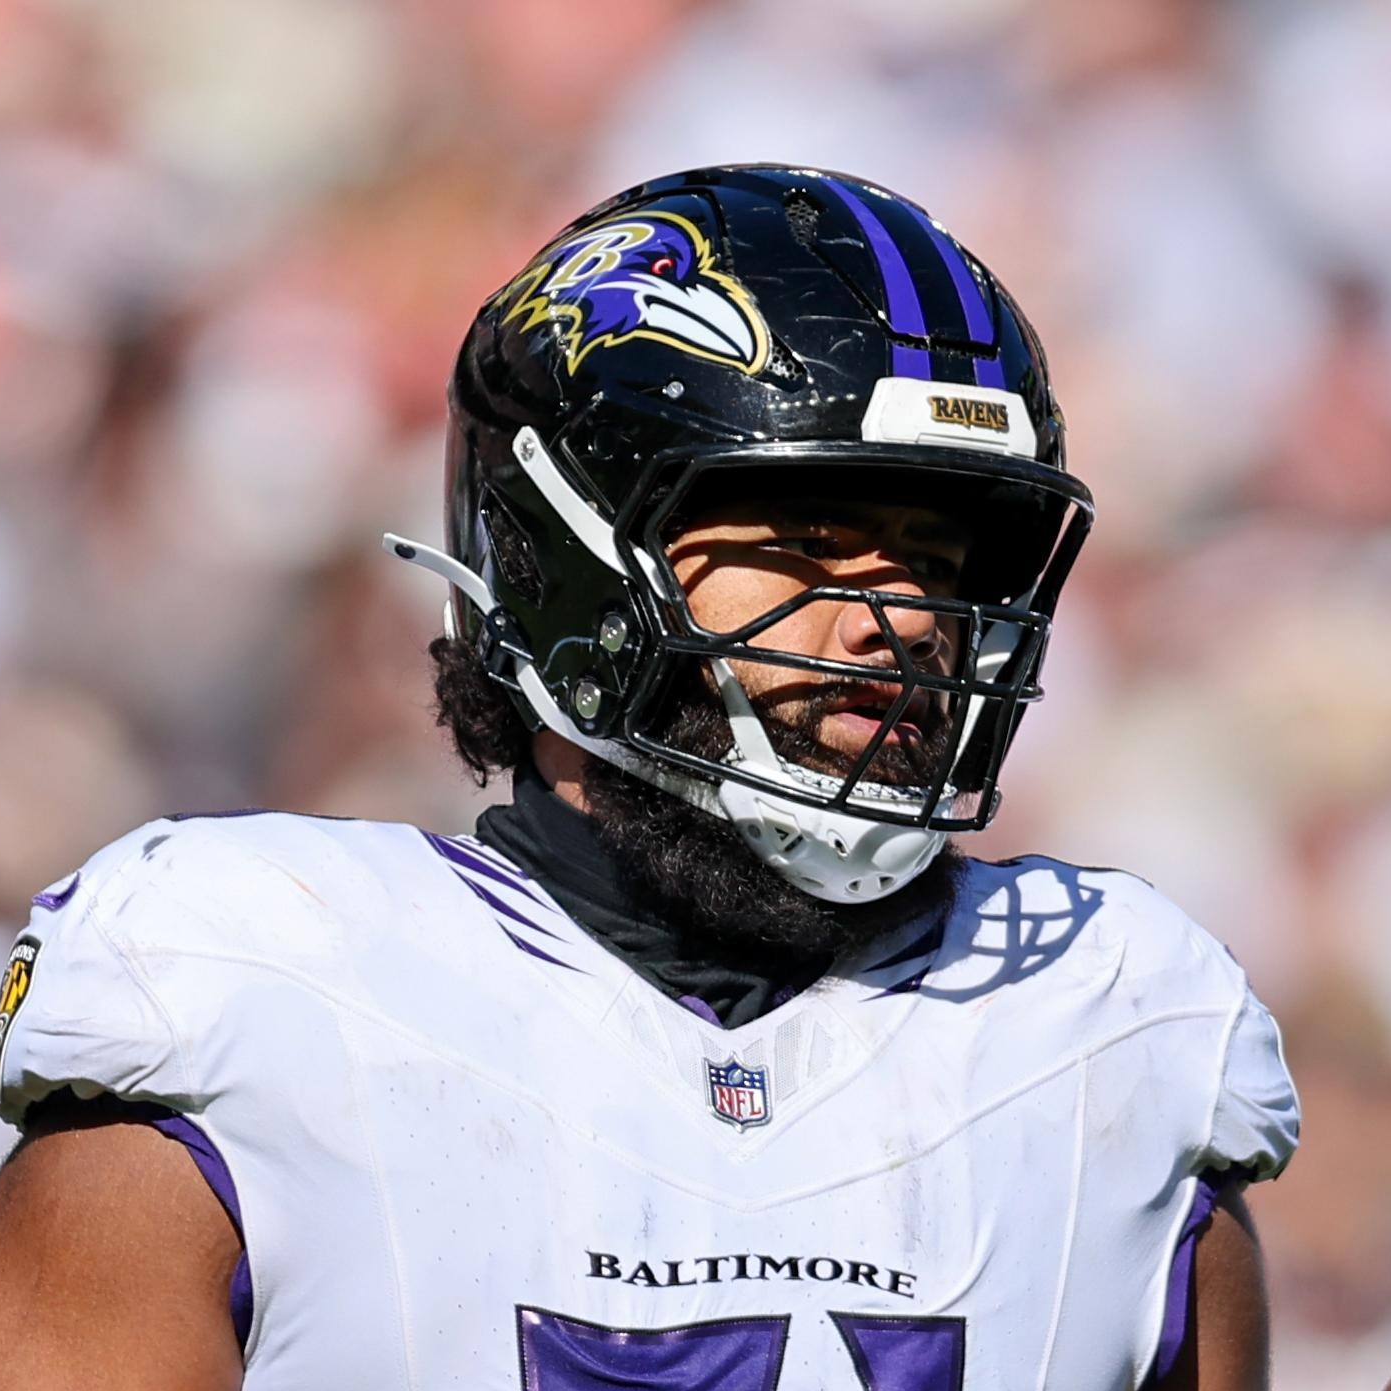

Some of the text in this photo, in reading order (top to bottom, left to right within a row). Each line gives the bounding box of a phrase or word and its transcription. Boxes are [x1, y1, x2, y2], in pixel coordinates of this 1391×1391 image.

[927, 396, 1009, 433] RAVENS
[715, 1085, 762, 1119] NFL
[585, 1250, 917, 1299] BALTIMORE
